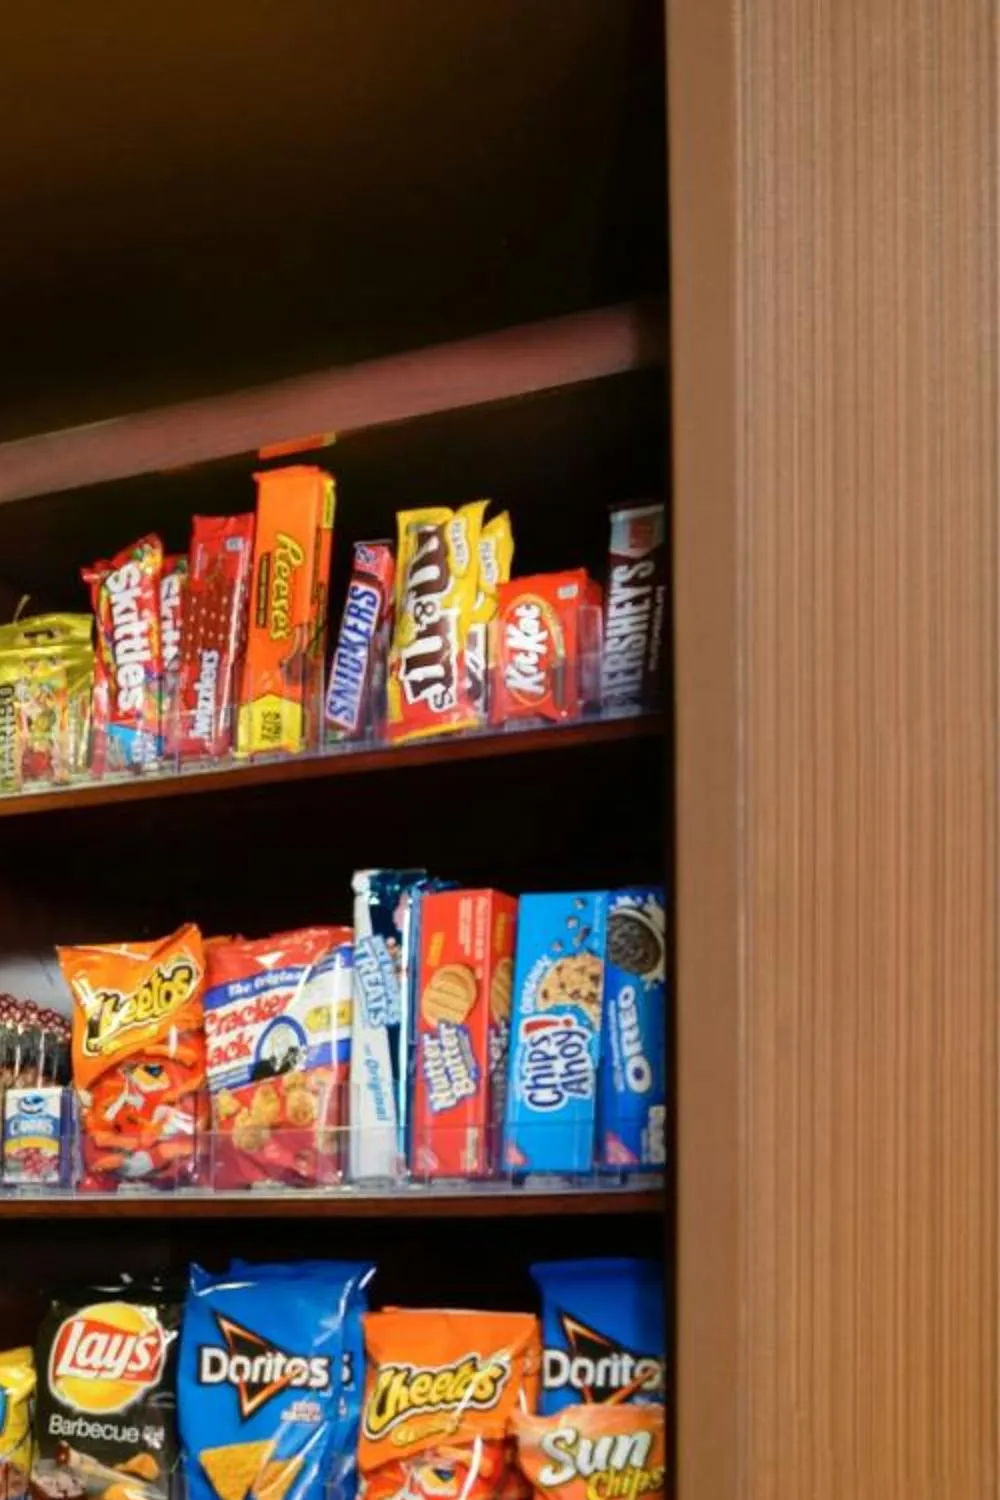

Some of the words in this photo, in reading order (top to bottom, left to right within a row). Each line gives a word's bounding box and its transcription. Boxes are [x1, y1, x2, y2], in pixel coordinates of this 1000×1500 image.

[105, 563, 152, 711] Skittles
[328, 584, 379, 722] SNICKERS
[354, 940, 387, 1027] TREATS
[439, 1021, 477, 1096] Butter
[618, 985, 652, 1093] OREO
[201, 1347, 330, 1388] Doritos
[367, 1356, 506, 1433] Cheetos
[48, 1413, 139, 1443] Barbecue
[538, 1427, 653, 1487] Sun
